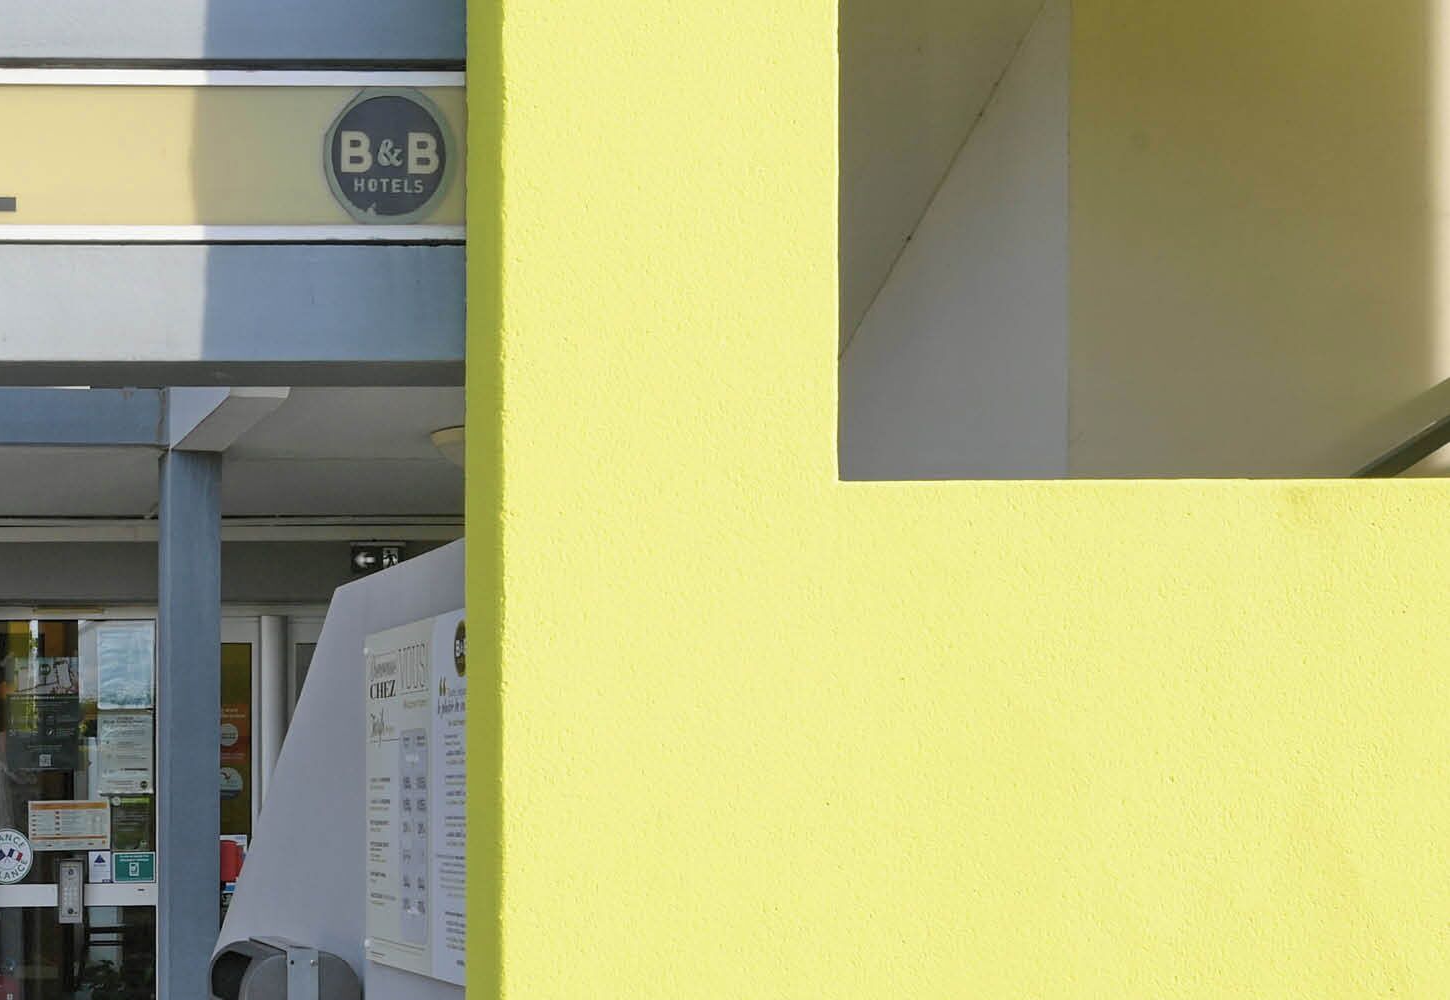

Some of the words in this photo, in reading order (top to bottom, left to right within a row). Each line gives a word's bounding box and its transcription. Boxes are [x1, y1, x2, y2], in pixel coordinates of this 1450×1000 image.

[340, 130, 440, 175] B&B
[353, 177, 425, 194] HOTELS
[369, 679, 397, 700] CHEZ
